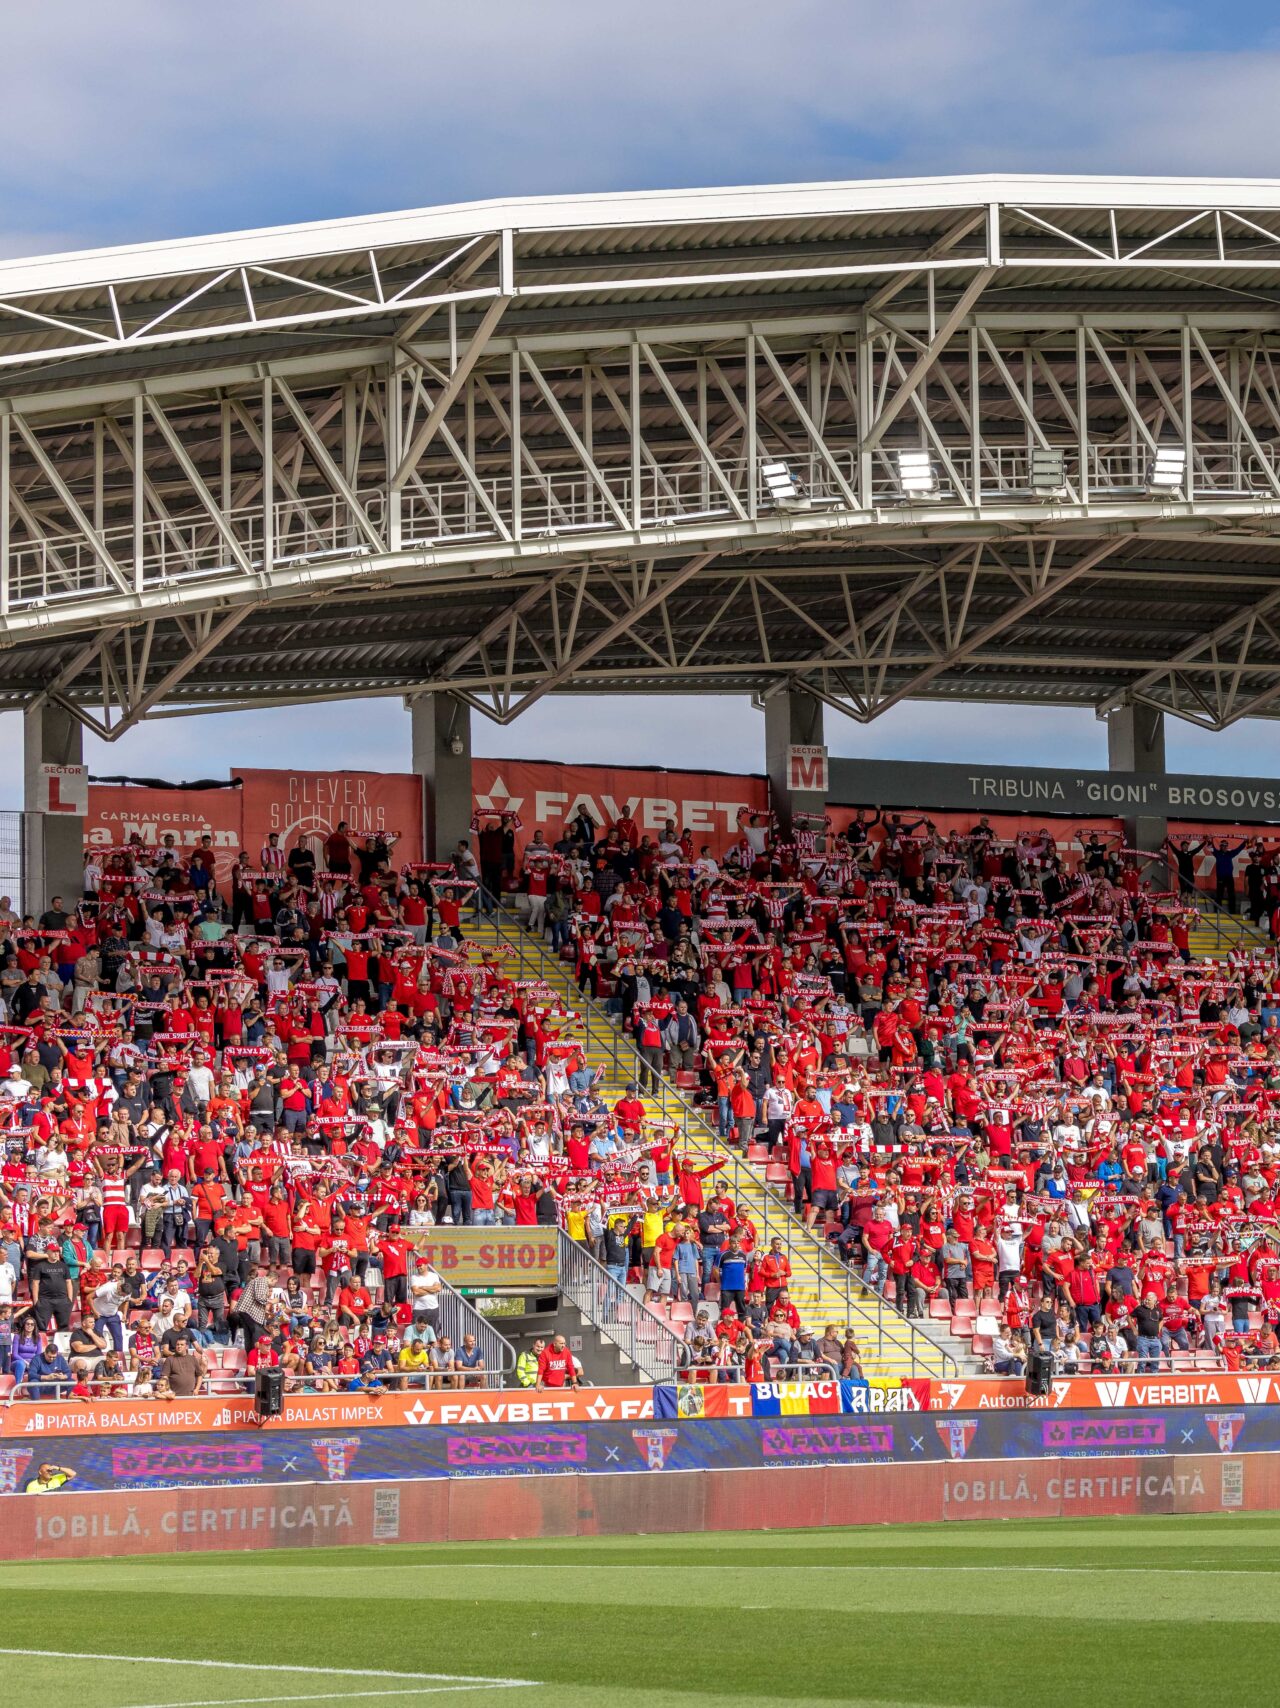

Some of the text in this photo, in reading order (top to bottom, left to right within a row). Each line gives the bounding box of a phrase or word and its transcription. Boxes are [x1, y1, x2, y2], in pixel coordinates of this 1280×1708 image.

[792, 746, 822, 754] SECTOR
[44, 766, 81, 775] SECTOR
[791, 756, 824, 788] M
[48, 777, 76, 812] L
[289, 777, 367, 805] CLEVER
[968, 777, 1065, 799] TRIBUNA
[100, 811, 206, 822] CARMANGERIA
[270, 804, 385, 831] SOLUTIONS
[535, 790, 749, 833] FAVBET
[83, 823, 240, 847] a Marin
[104, 1145, 139, 1154] UTA ARAD
[423, 1244, 555, 1269] TB-SHOP
[757, 1382, 832, 1400] BUJAC
[979, 1393, 1049, 1409] Autonom
[1132, 1383, 1221, 1405] VERBITA
[47, 1410, 203, 1429] PIATRĂ BALAST IMPEX
[286, 1407, 338, 1422] BALAST
[341, 1405, 383, 1420] IMPEX
[440, 1402, 575, 1424] FAVBET
[792, 1432, 889, 1449] FAVBET
[1071, 1424, 1161, 1441] FAVBET
[479, 1440, 581, 1458] FAVBET
[1046, 1469, 1205, 1499] CERTIFICATĂ
[161, 1498, 353, 1534] CERTIFICATĂ
